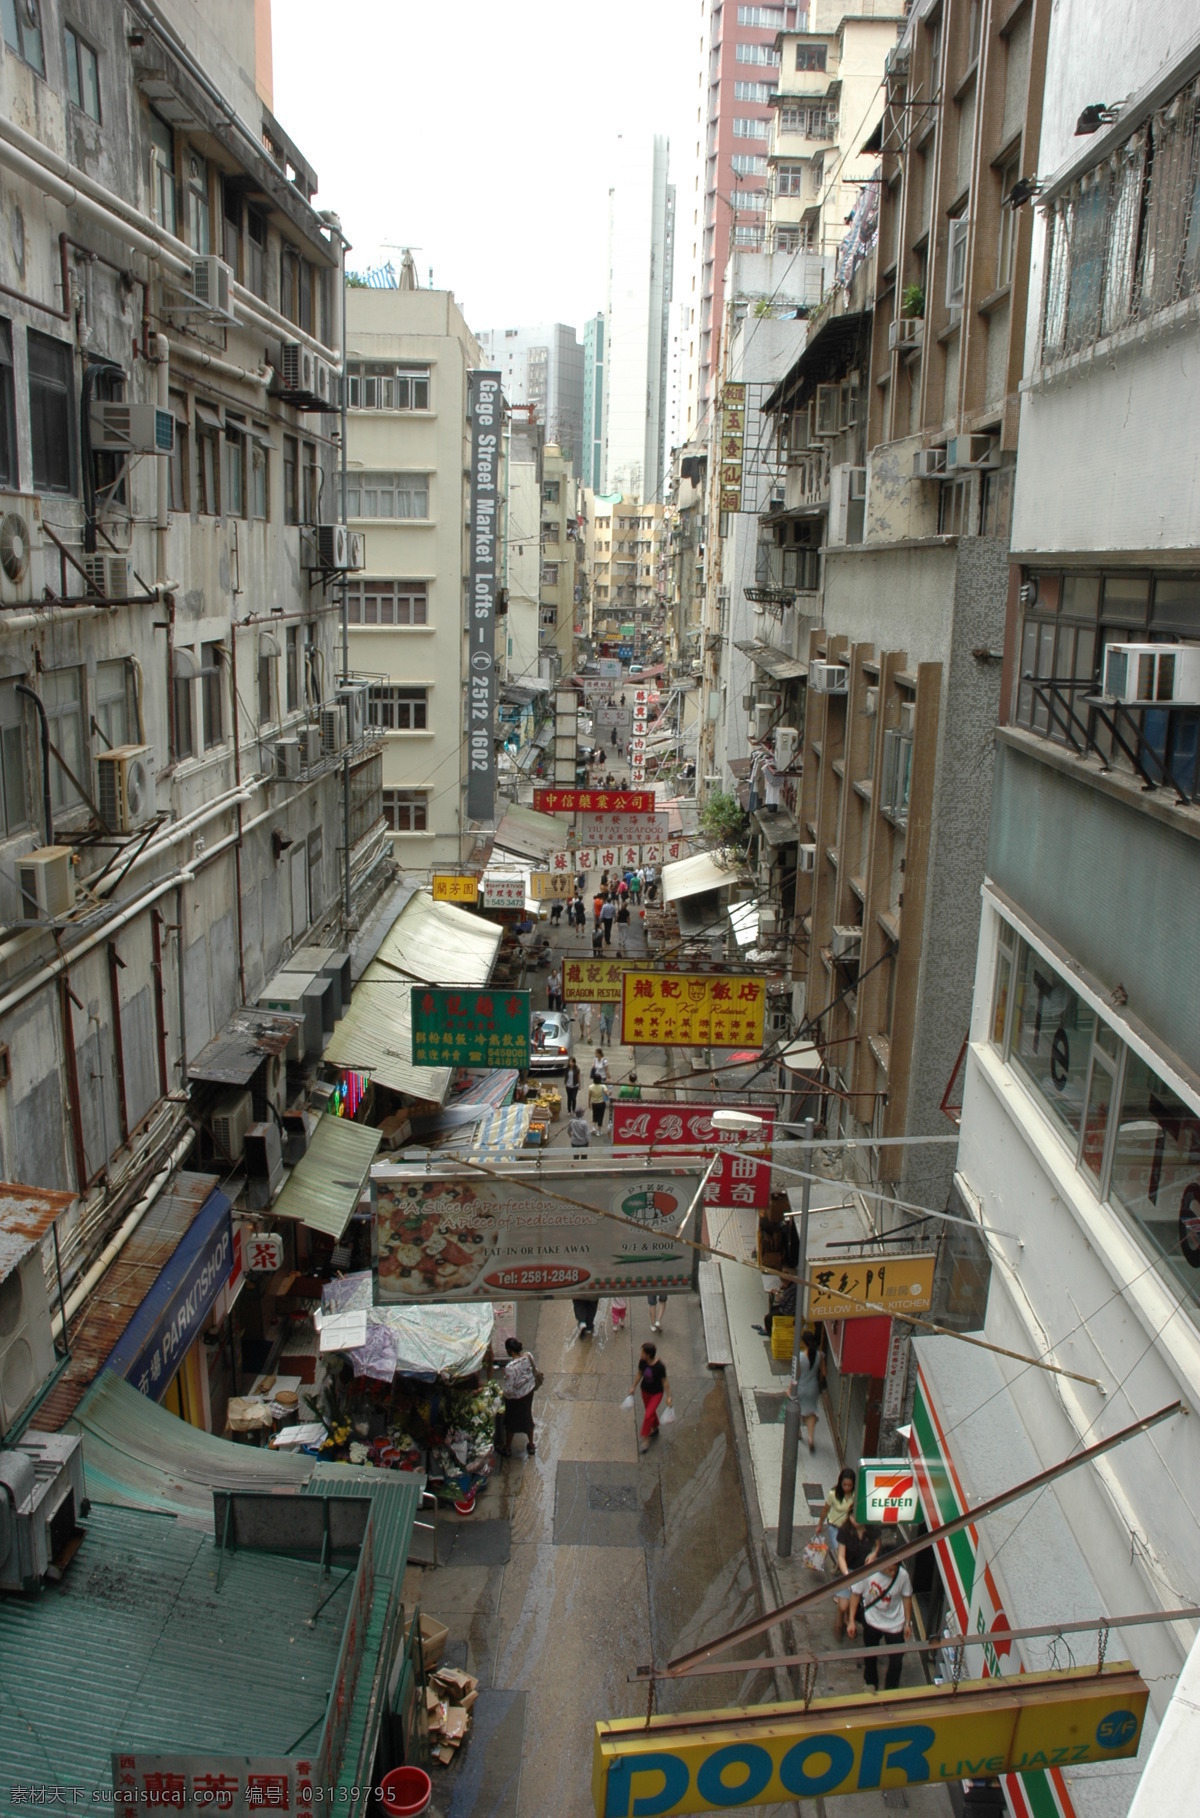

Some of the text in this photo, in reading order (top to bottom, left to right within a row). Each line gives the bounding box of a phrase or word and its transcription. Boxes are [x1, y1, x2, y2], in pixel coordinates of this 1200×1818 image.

[477, 380, 499, 427] Gage
[476, 433, 497, 491] Street
[475, 499, 495, 564] Market
[473, 572, 494, 619] Lofts
[471, 676, 489, 720] 2512
[470, 727, 488, 772] 1602
[546, 793, 643, 809] 中信藥業公司
[605, 826, 621, 834] FAT
[623, 826, 664, 834] SEAFOOD
[506, 899, 524, 907] 3473
[566, 988, 594, 998] DRAGON
[463, 1200, 482, 1215] of
[483, 1198, 555, 1213] Perfection
[441, 1218, 455, 1230] A
[457, 1216, 496, 1229] Piece
[497, 1215, 514, 1230] of
[251, 1243, 277, 1269] 茶
[520, 1247, 534, 1255] OR
[537, 1246, 561, 1254] TAKE
[564, 1244, 592, 1254] AWAY
[621, 1243, 637, 1252] 9/F
[652, 1242, 675, 1250] ROOF
[497, 1269, 579, 1284] Tel: 2581-2848
[810, 1303, 851, 1316] YELLOW
[888, 1298, 930, 1310] KITCHEN
[940, 1745, 1091, 1777] LIVE JAZZ
[604, 1724, 936, 1818] DOOR
